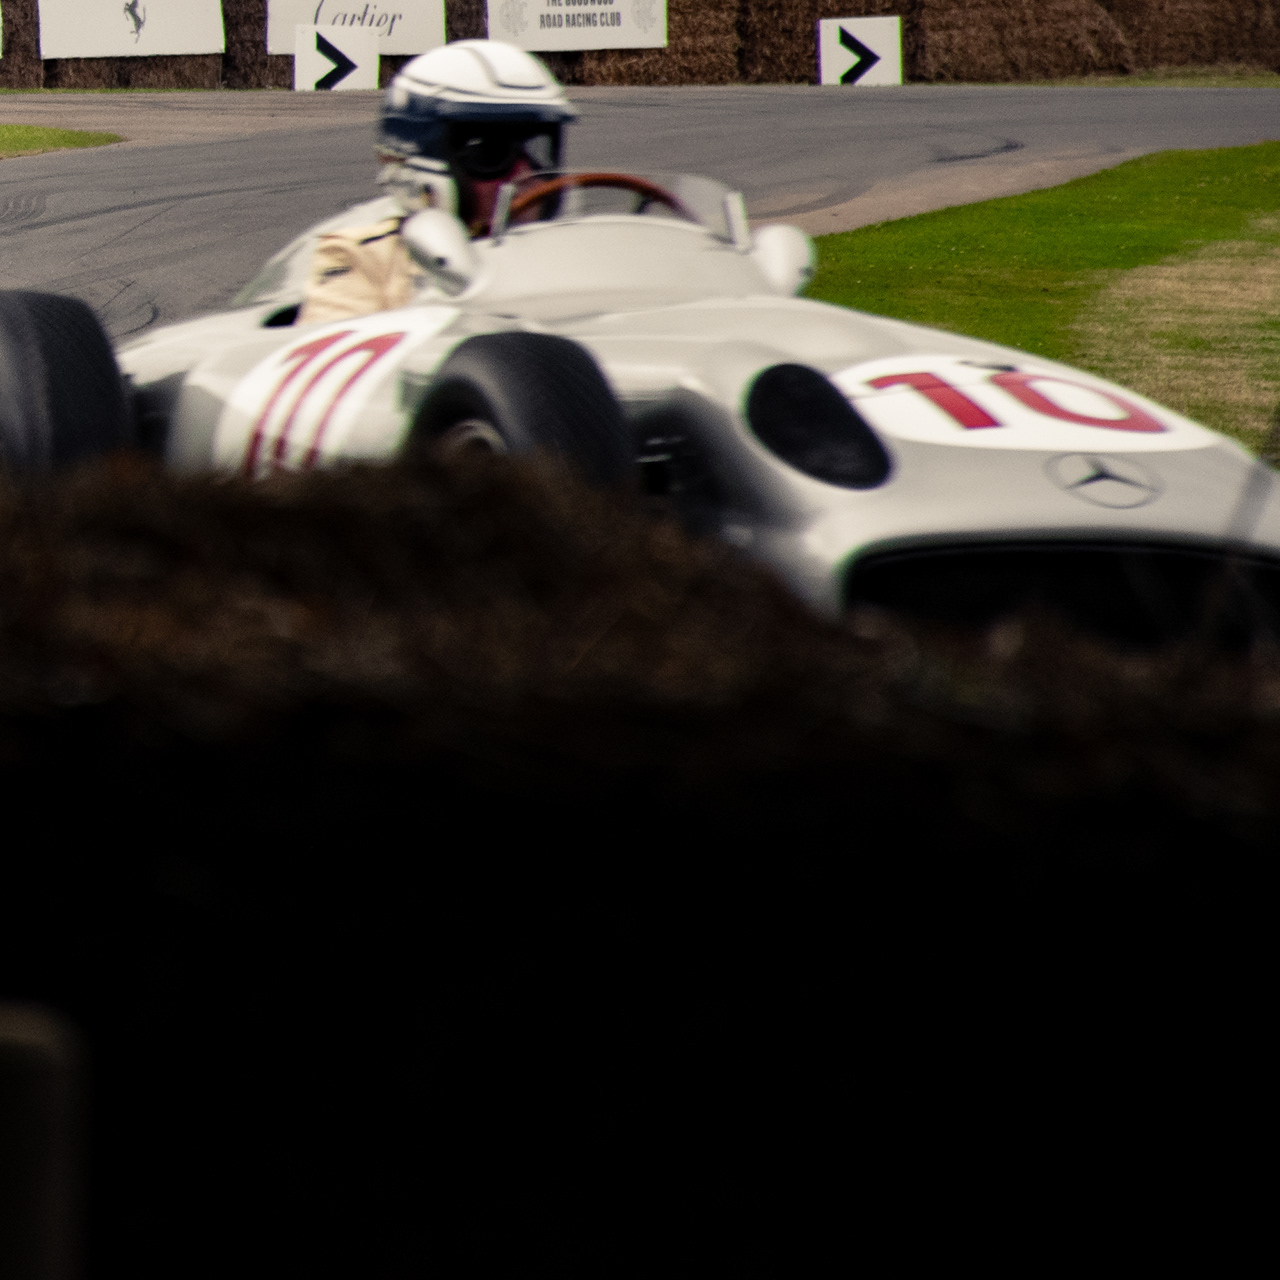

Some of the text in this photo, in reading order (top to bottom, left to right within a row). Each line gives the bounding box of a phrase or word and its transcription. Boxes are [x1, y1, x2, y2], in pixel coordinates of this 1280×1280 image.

[540, 11, 622, 30] ROAD RACING CLUB
[862, 371, 1171, 433] 10
